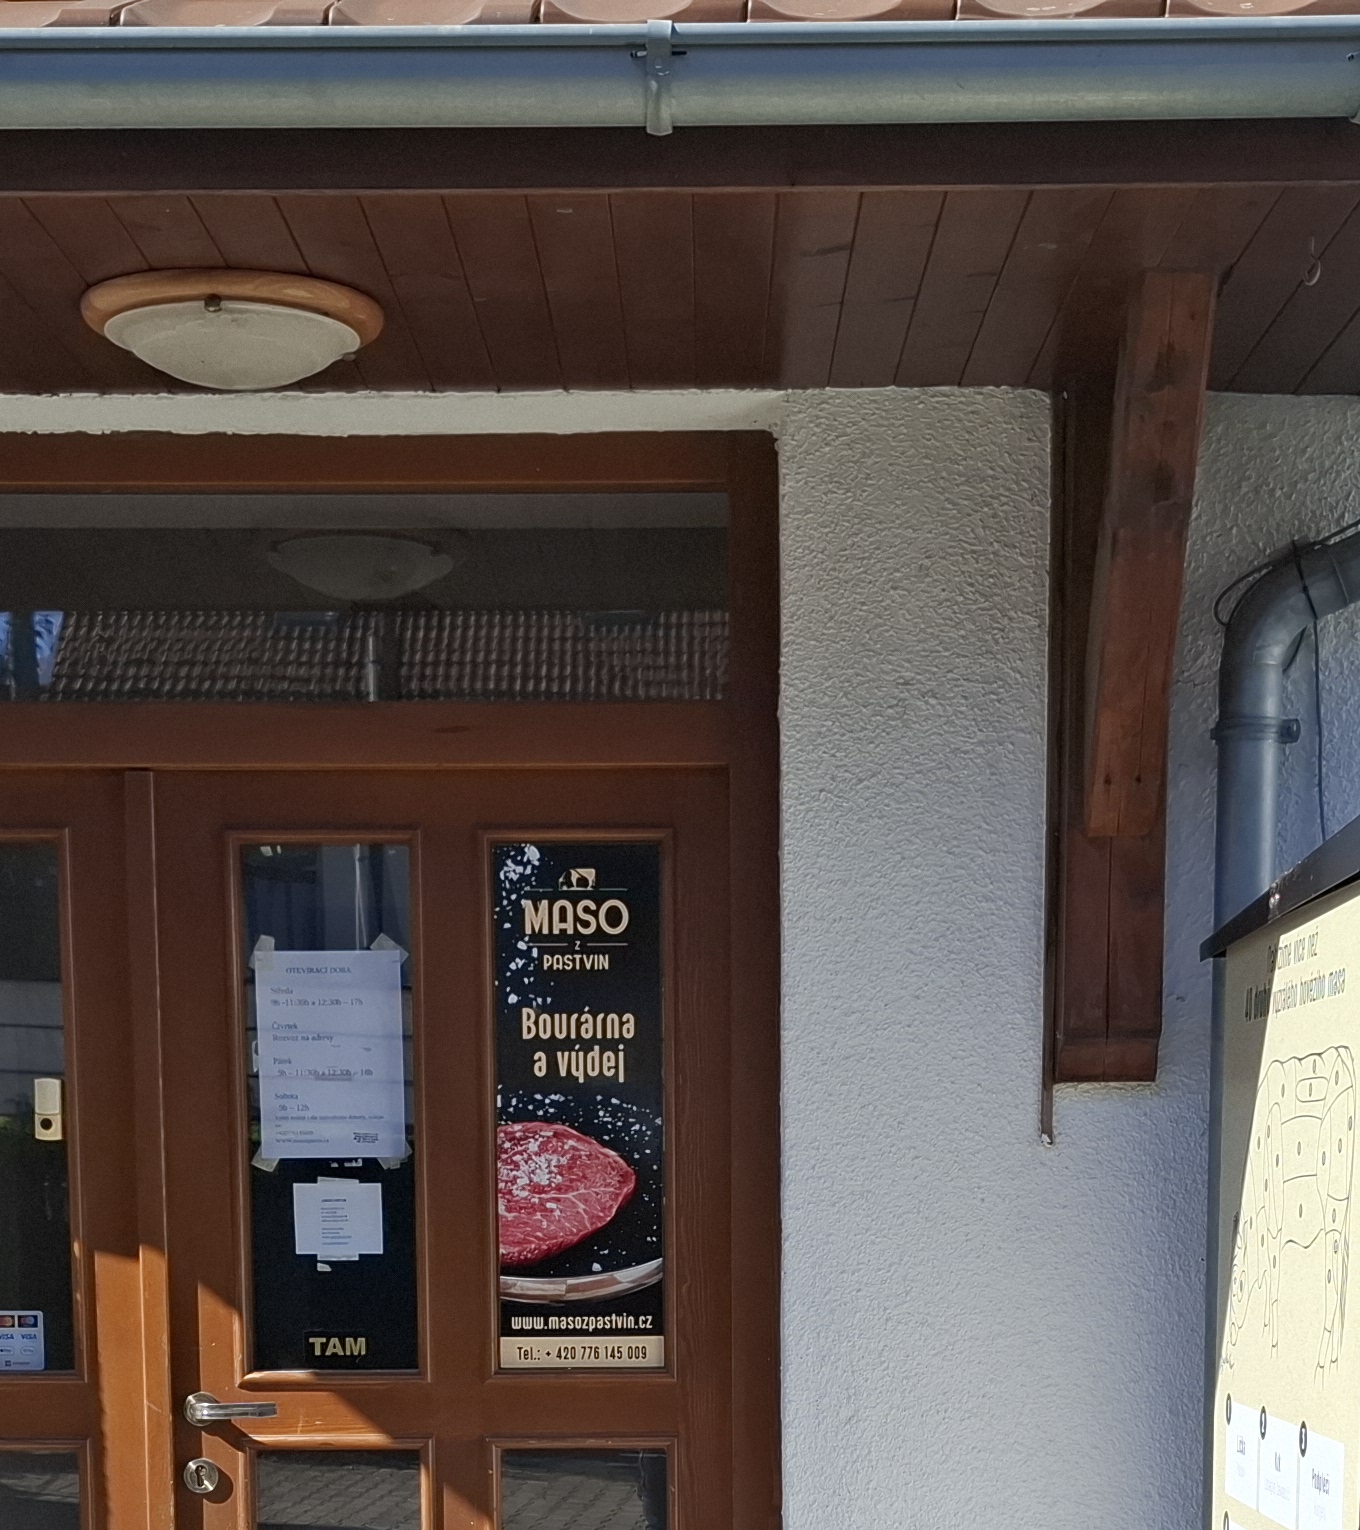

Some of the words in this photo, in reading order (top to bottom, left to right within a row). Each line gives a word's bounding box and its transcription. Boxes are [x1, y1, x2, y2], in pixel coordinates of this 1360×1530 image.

[524, 899, 629, 935] MASO
[1293, 933, 1306, 965] více
[1306, 925, 1319, 960] než
[543, 954, 609, 970] PASTVIN
[1298, 969, 1326, 1006] hovězího
[1327, 967, 1346, 998] masa
[271, 1021, 299, 1030] Čtvrtek
[522, 1006, 635, 1040] Bourárna
[272, 1034, 299, 1042] Rozvoz
[311, 1033, 334, 1043] adresy
[272, 1057, 292, 1065] Pátek
[533, 1051, 547, 1077] a
[557, 1043, 625, 1083] výdej
[274, 1092, 299, 1100] Sobota
[511, 1313, 653, 1332] www.masozpastvin.cz
[309, 1337, 366, 1356] TAM
[517, 1346, 541, 1361] Tel.:
[556, 1346, 576, 1360] 420
[581, 1346, 600, 1360] 776
[604, 1345, 623, 1360] 145
[627, 1345, 647, 1360] 009
